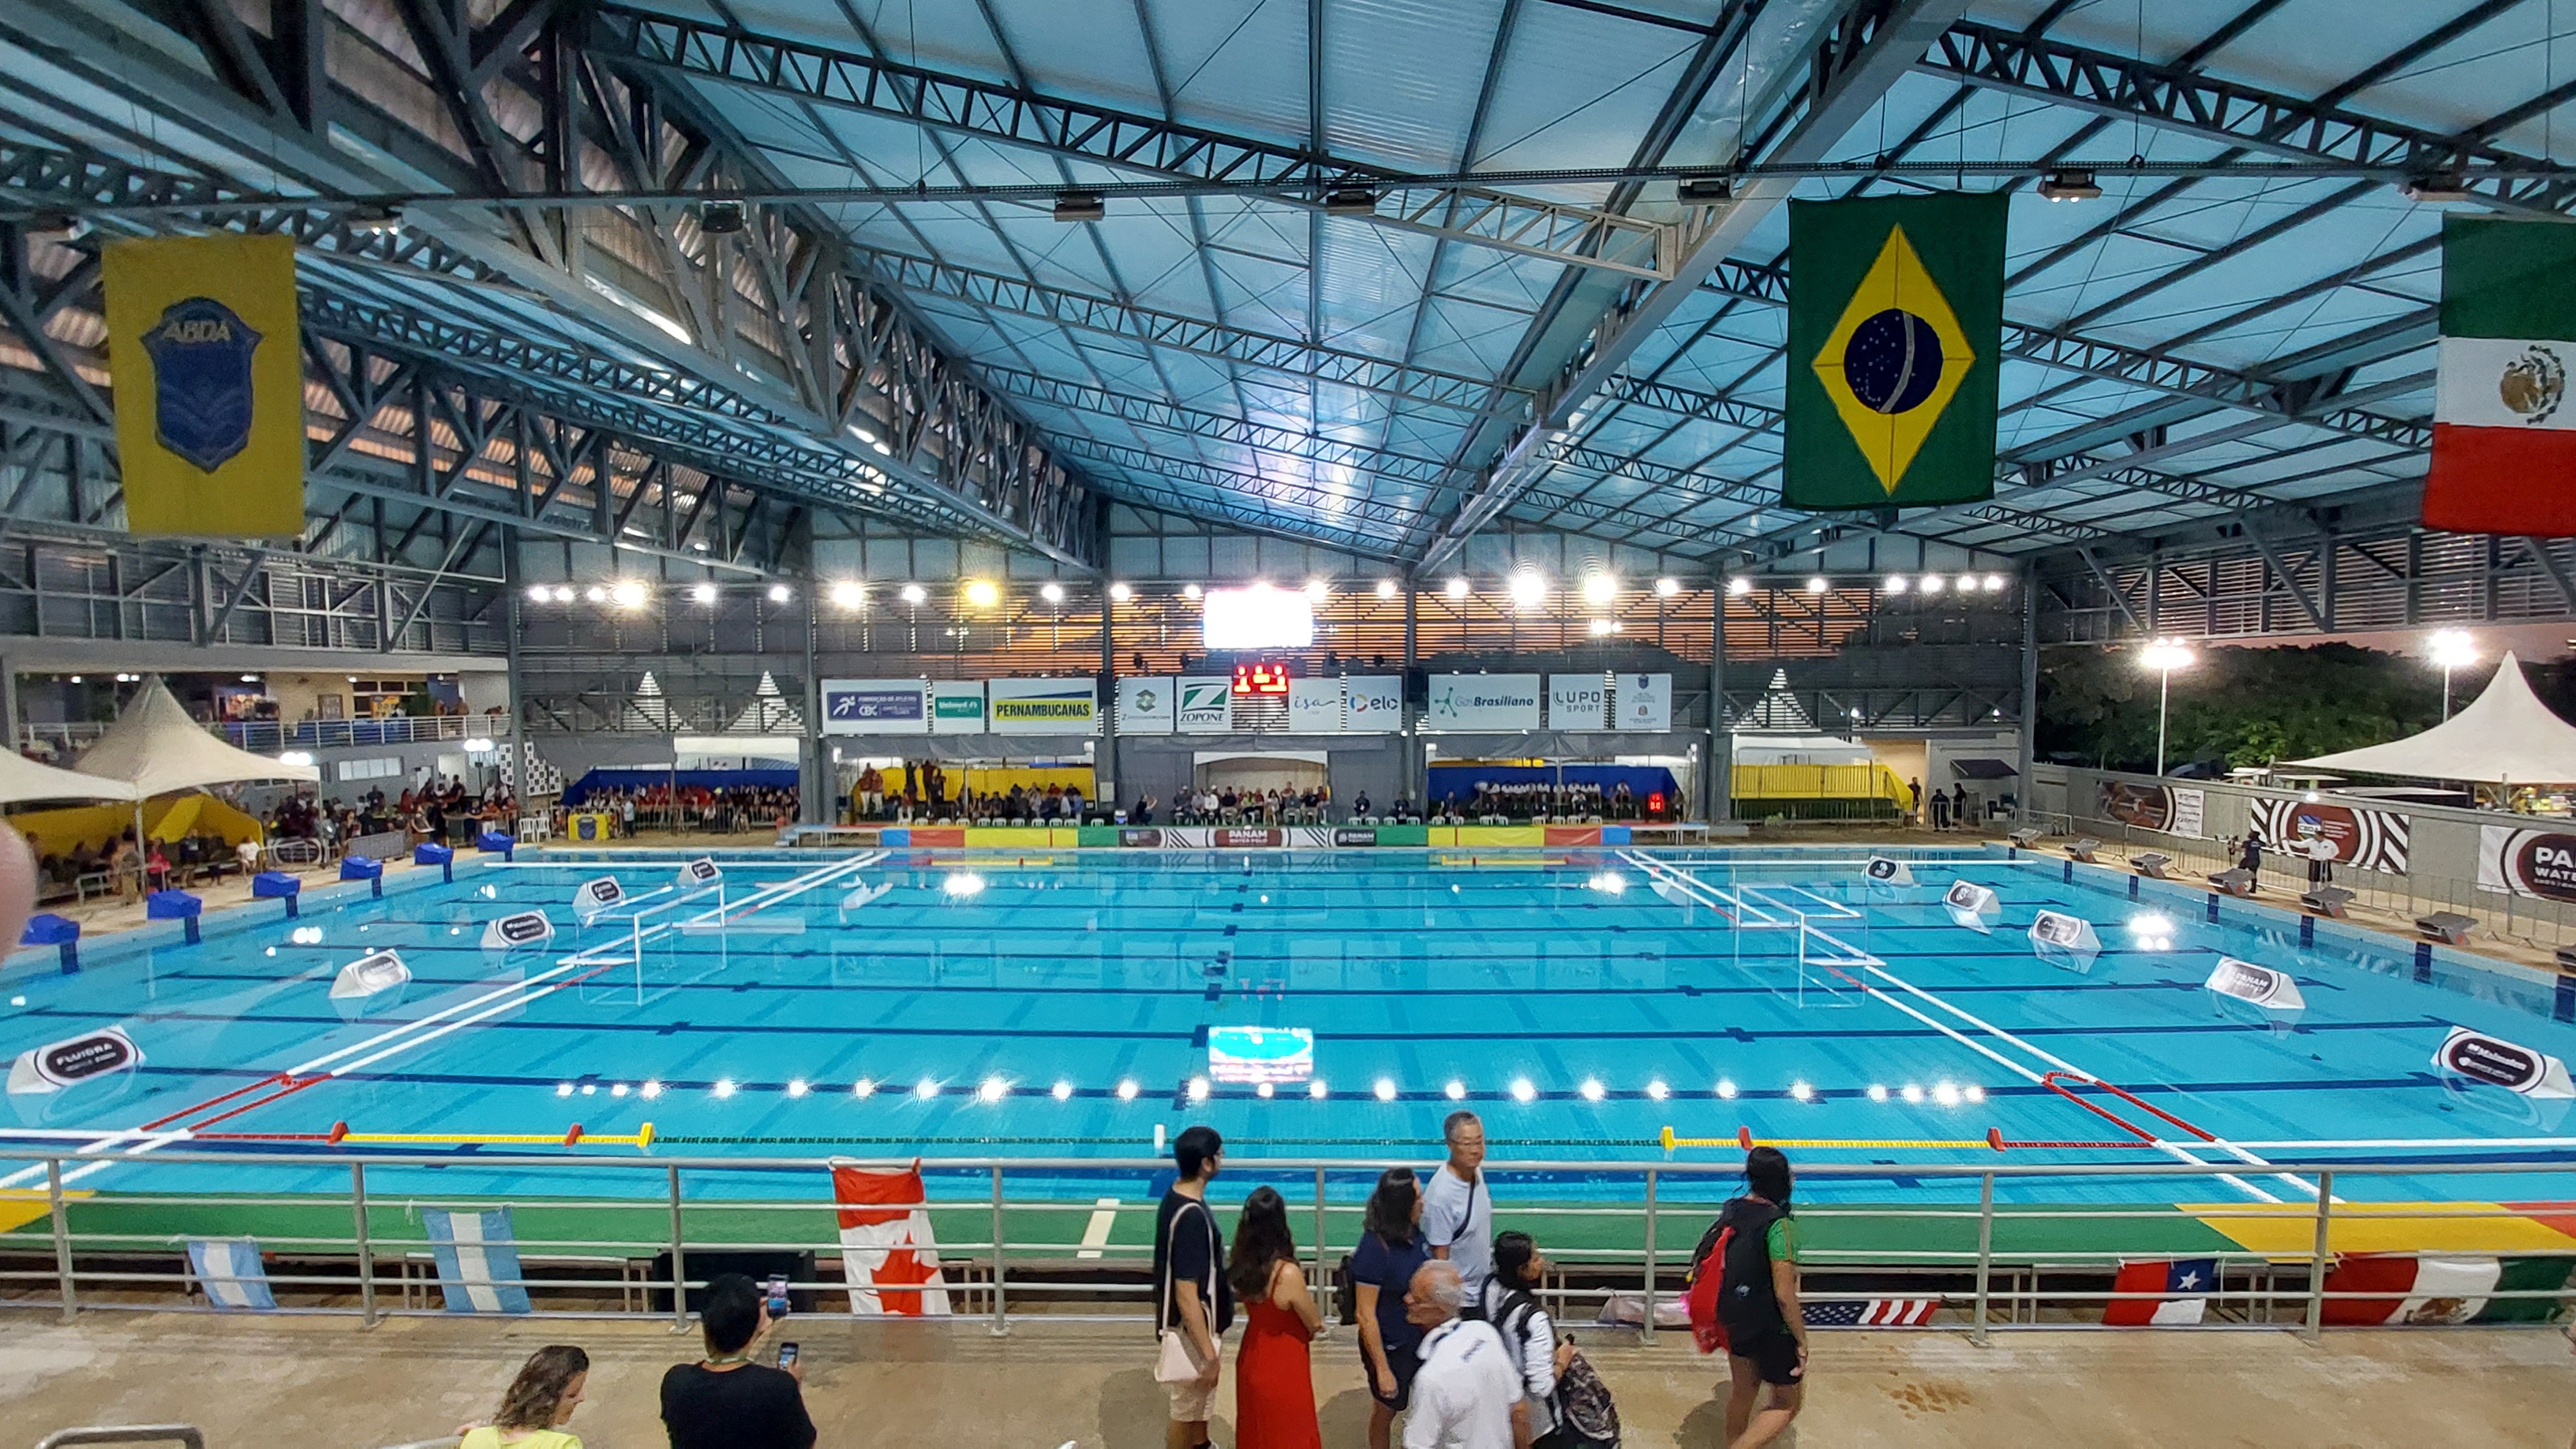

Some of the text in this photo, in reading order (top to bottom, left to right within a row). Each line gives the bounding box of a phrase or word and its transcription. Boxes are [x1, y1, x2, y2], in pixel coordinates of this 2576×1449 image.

[162, 320, 231, 344] ABDA
[1553, 691, 1601, 706] LUPO
[996, 702, 1090, 717] PERNAMBUCANAS
[1179, 713, 1224, 722] ZOPONE
[1229, 829, 1268, 838] PANAM
[2535, 846, 2576, 869] PA
[2235, 972, 2270, 989] PANAM
